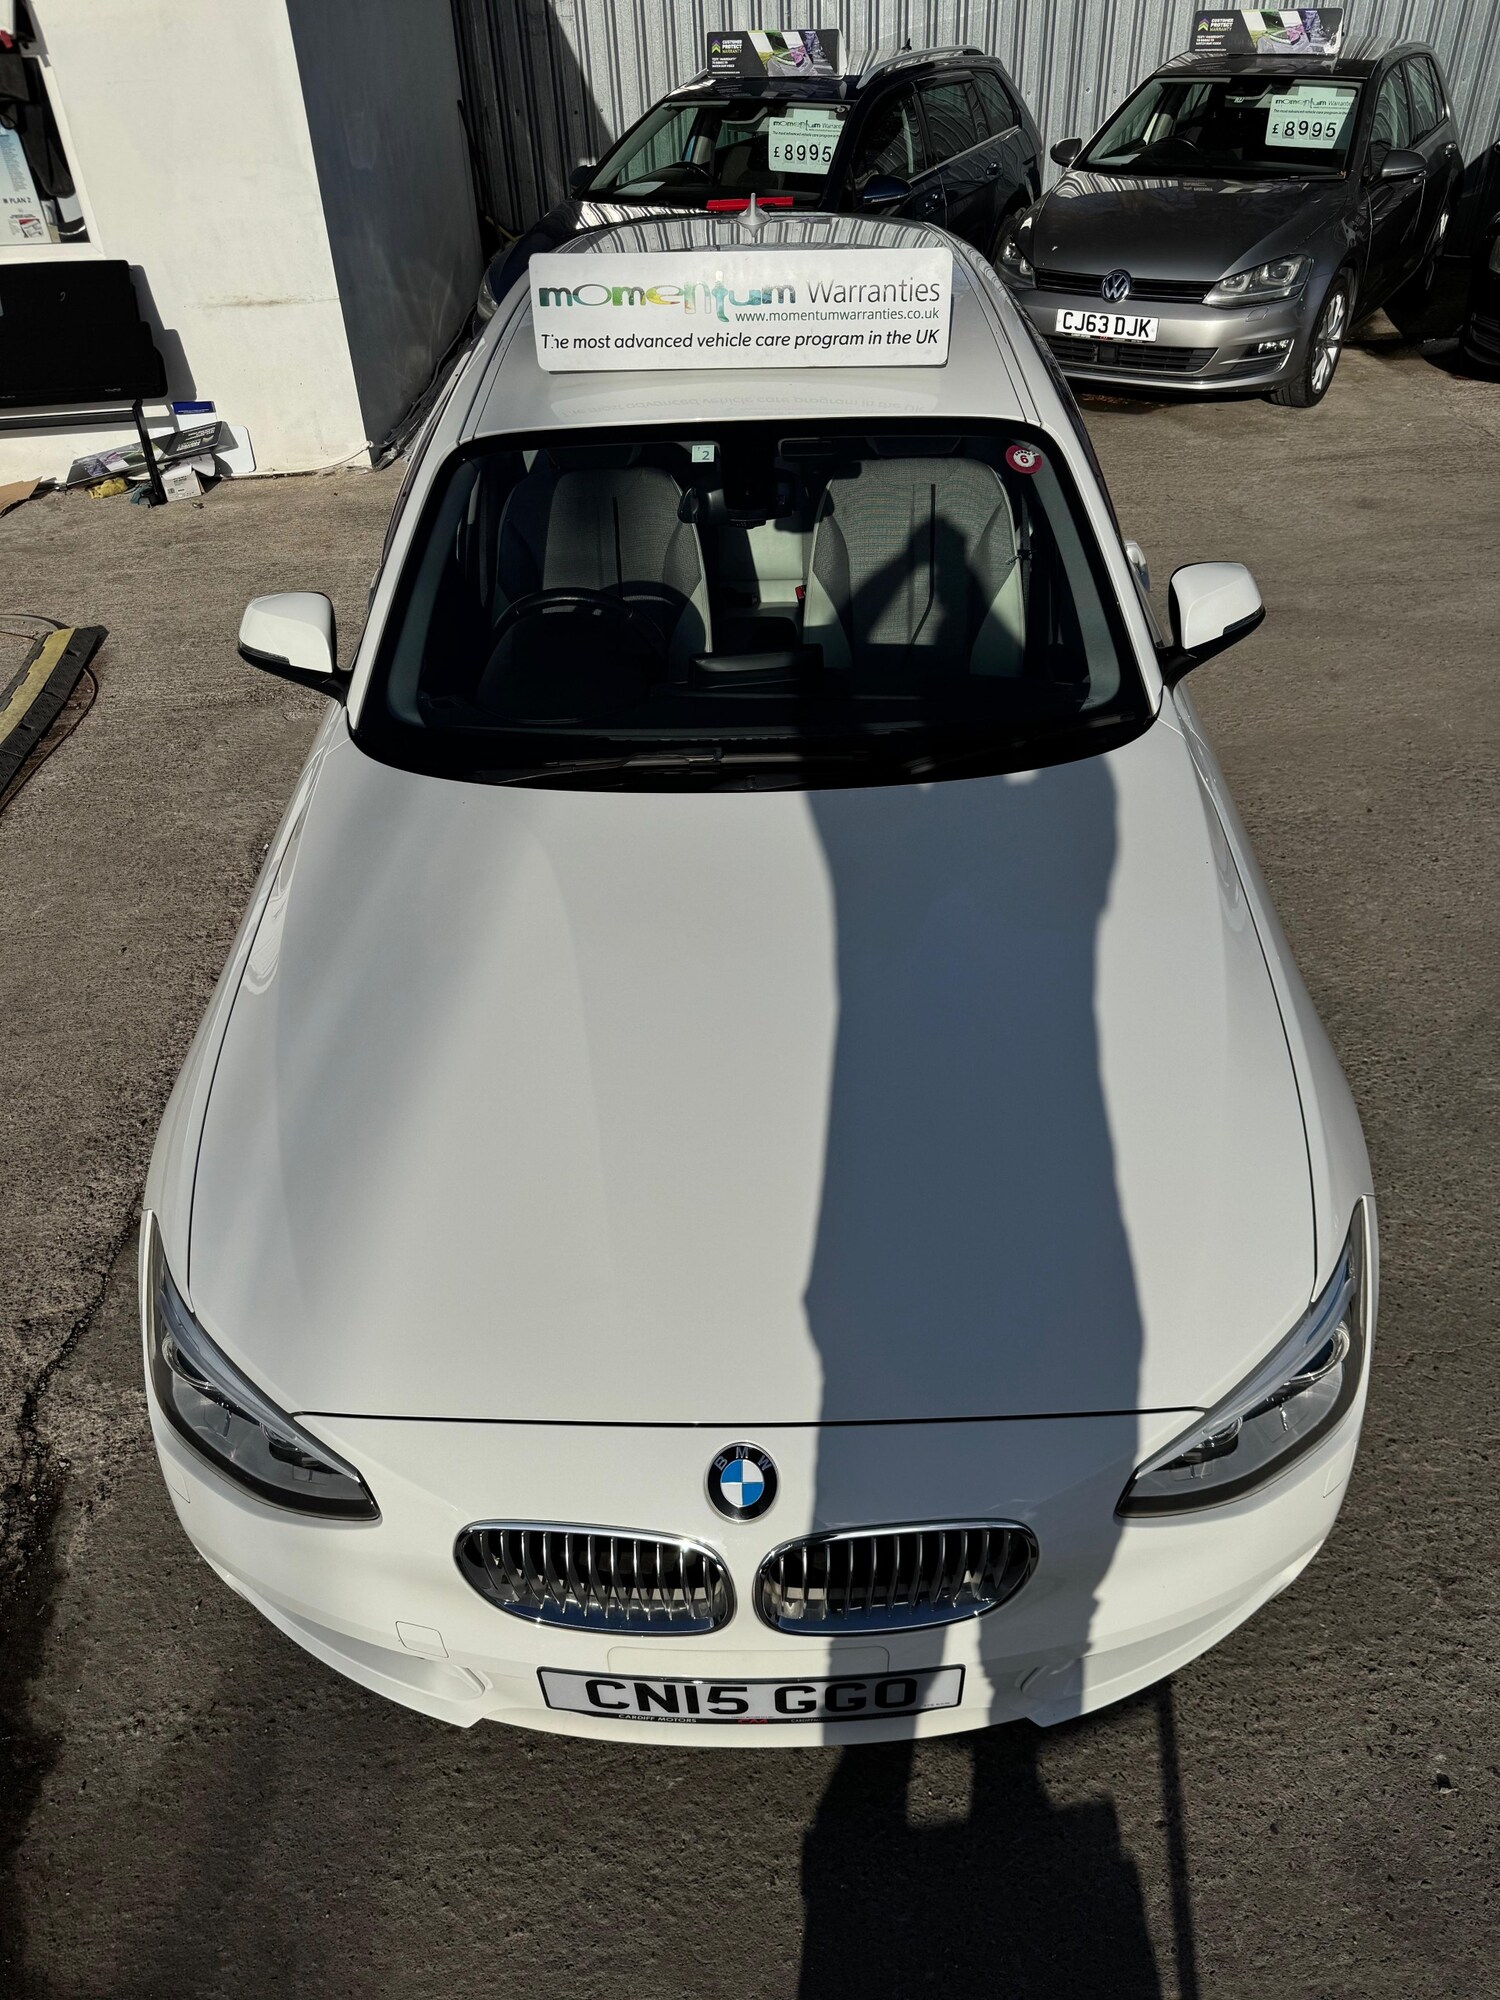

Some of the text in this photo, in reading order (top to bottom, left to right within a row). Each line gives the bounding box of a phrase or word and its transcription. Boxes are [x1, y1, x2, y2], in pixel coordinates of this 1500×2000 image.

[1272, 120, 1337, 138] £ 8995
[773, 144, 832, 163] £ 8995
[538, 270, 941, 323] momentum Warranties
[735, 307, 940, 322] www.momentumwarranties.co.uk
[1062, 311, 1151, 338] CJ63 DJK
[573, 334, 611, 349] most
[614, 333, 693, 349] advanced
[697, 331, 752, 347] vehicle
[756, 334, 790, 347] care
[794, 332, 864, 350] program
[868, 330, 882, 345] in
[886, 330, 912, 345] the
[916, 329, 940, 344] UK
[702, 450, 710, 460] 2
[714, 1446, 773, 1472] BMW
[585, 1677, 918, 1715] CN15 GGO
[618, 1714, 697, 1724] CARDIFF MOTORS
